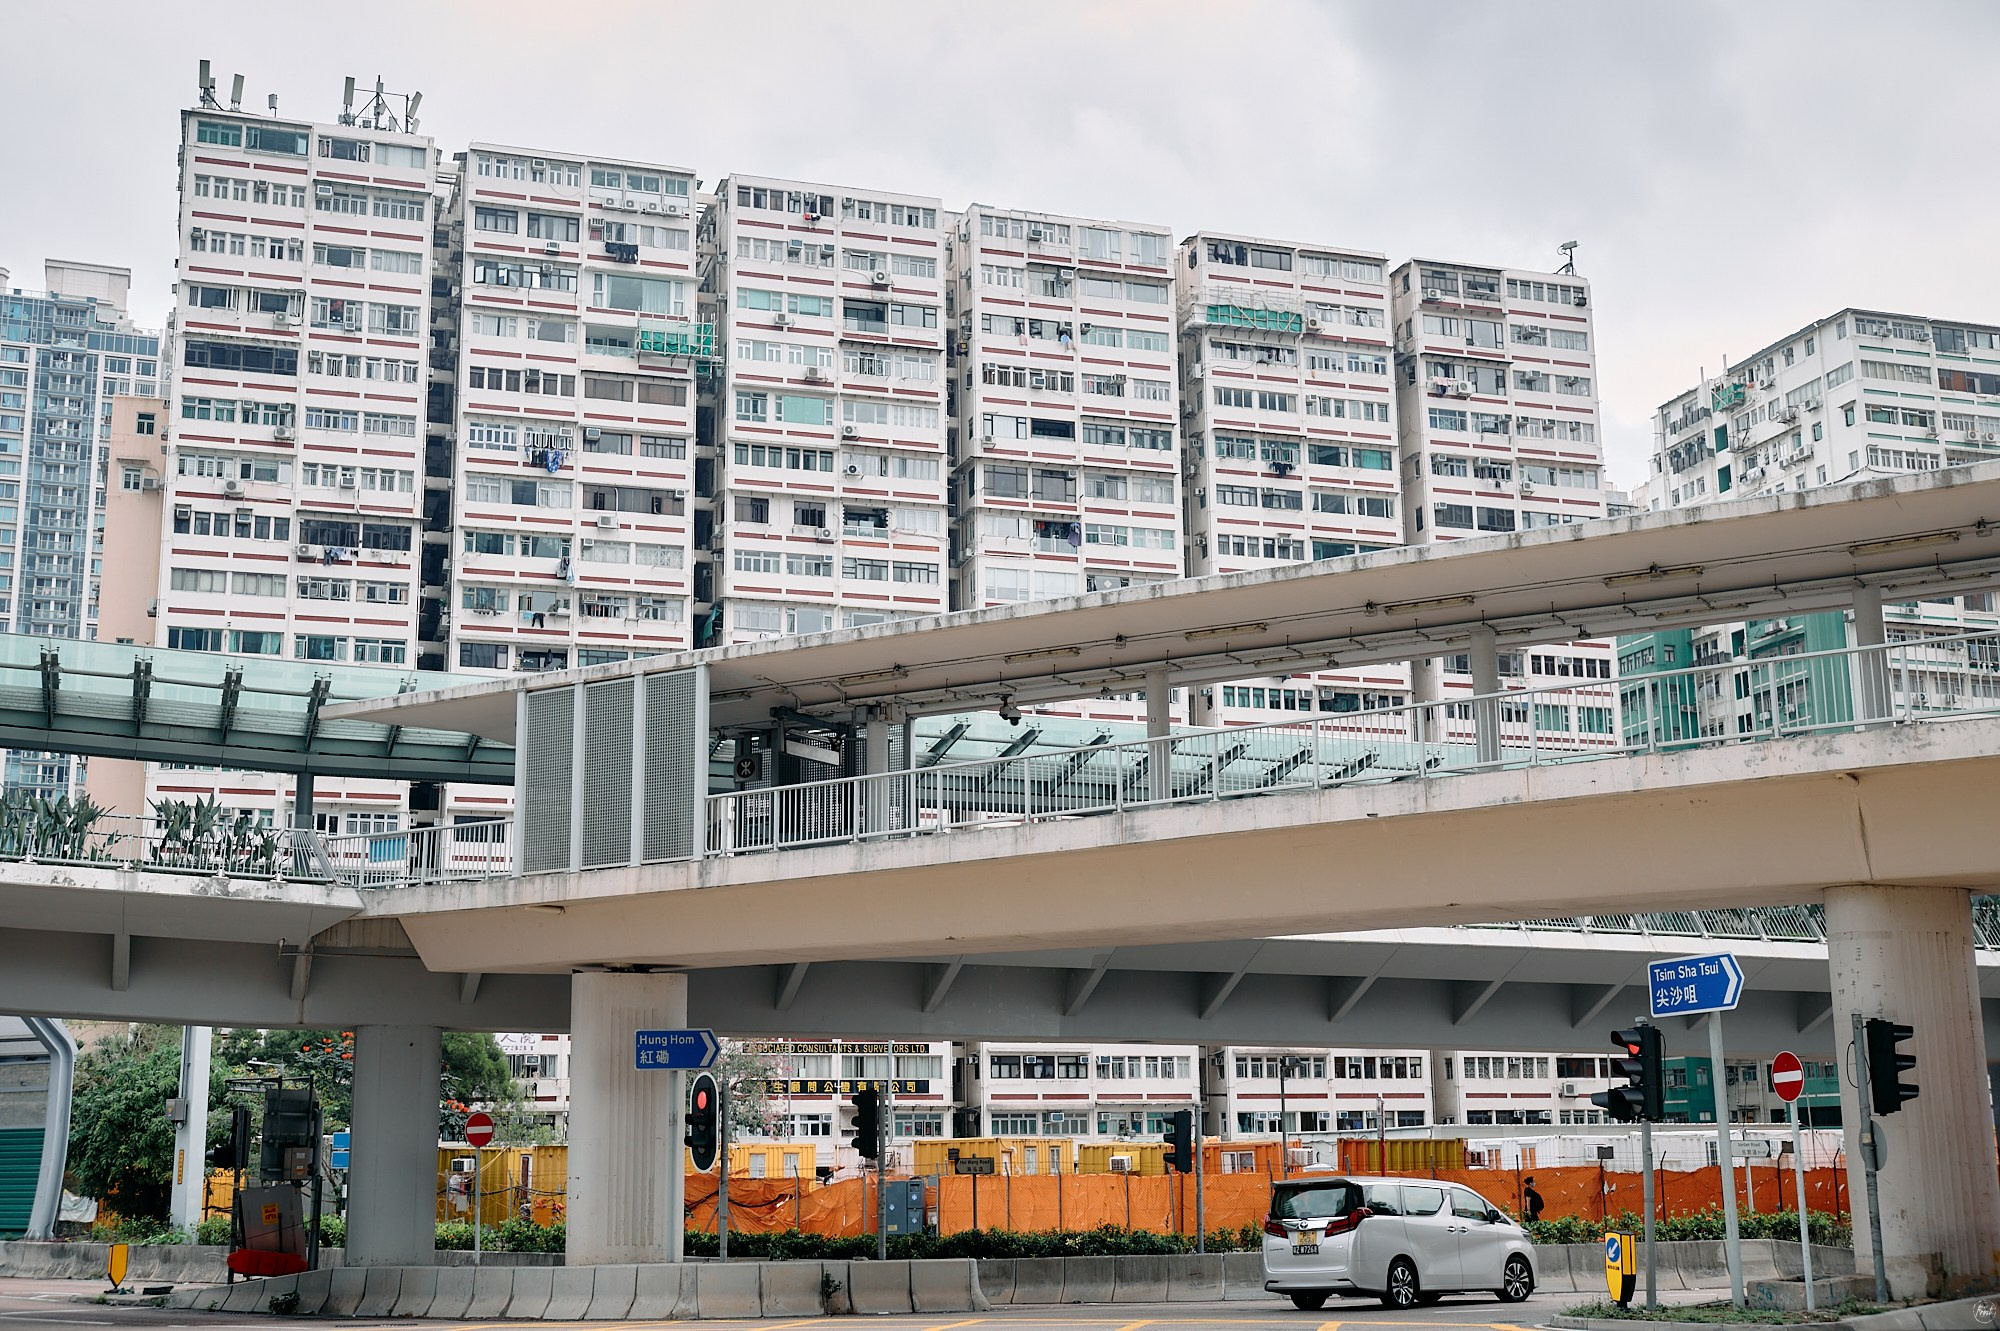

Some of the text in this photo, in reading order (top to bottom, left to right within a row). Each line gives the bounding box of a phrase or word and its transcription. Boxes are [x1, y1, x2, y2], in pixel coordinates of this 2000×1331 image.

[1653, 961, 1719, 982] Tsim Sha Tsui
[1656, 984, 1698, 1008] 尖沙咀
[640, 1035, 694, 1047] Hung Hom
[749, 1044, 927, 1053] SOCIATED CONSULTANTS & SURVEORS LTD.
[640, 1049, 670, 1064] 紅磡
